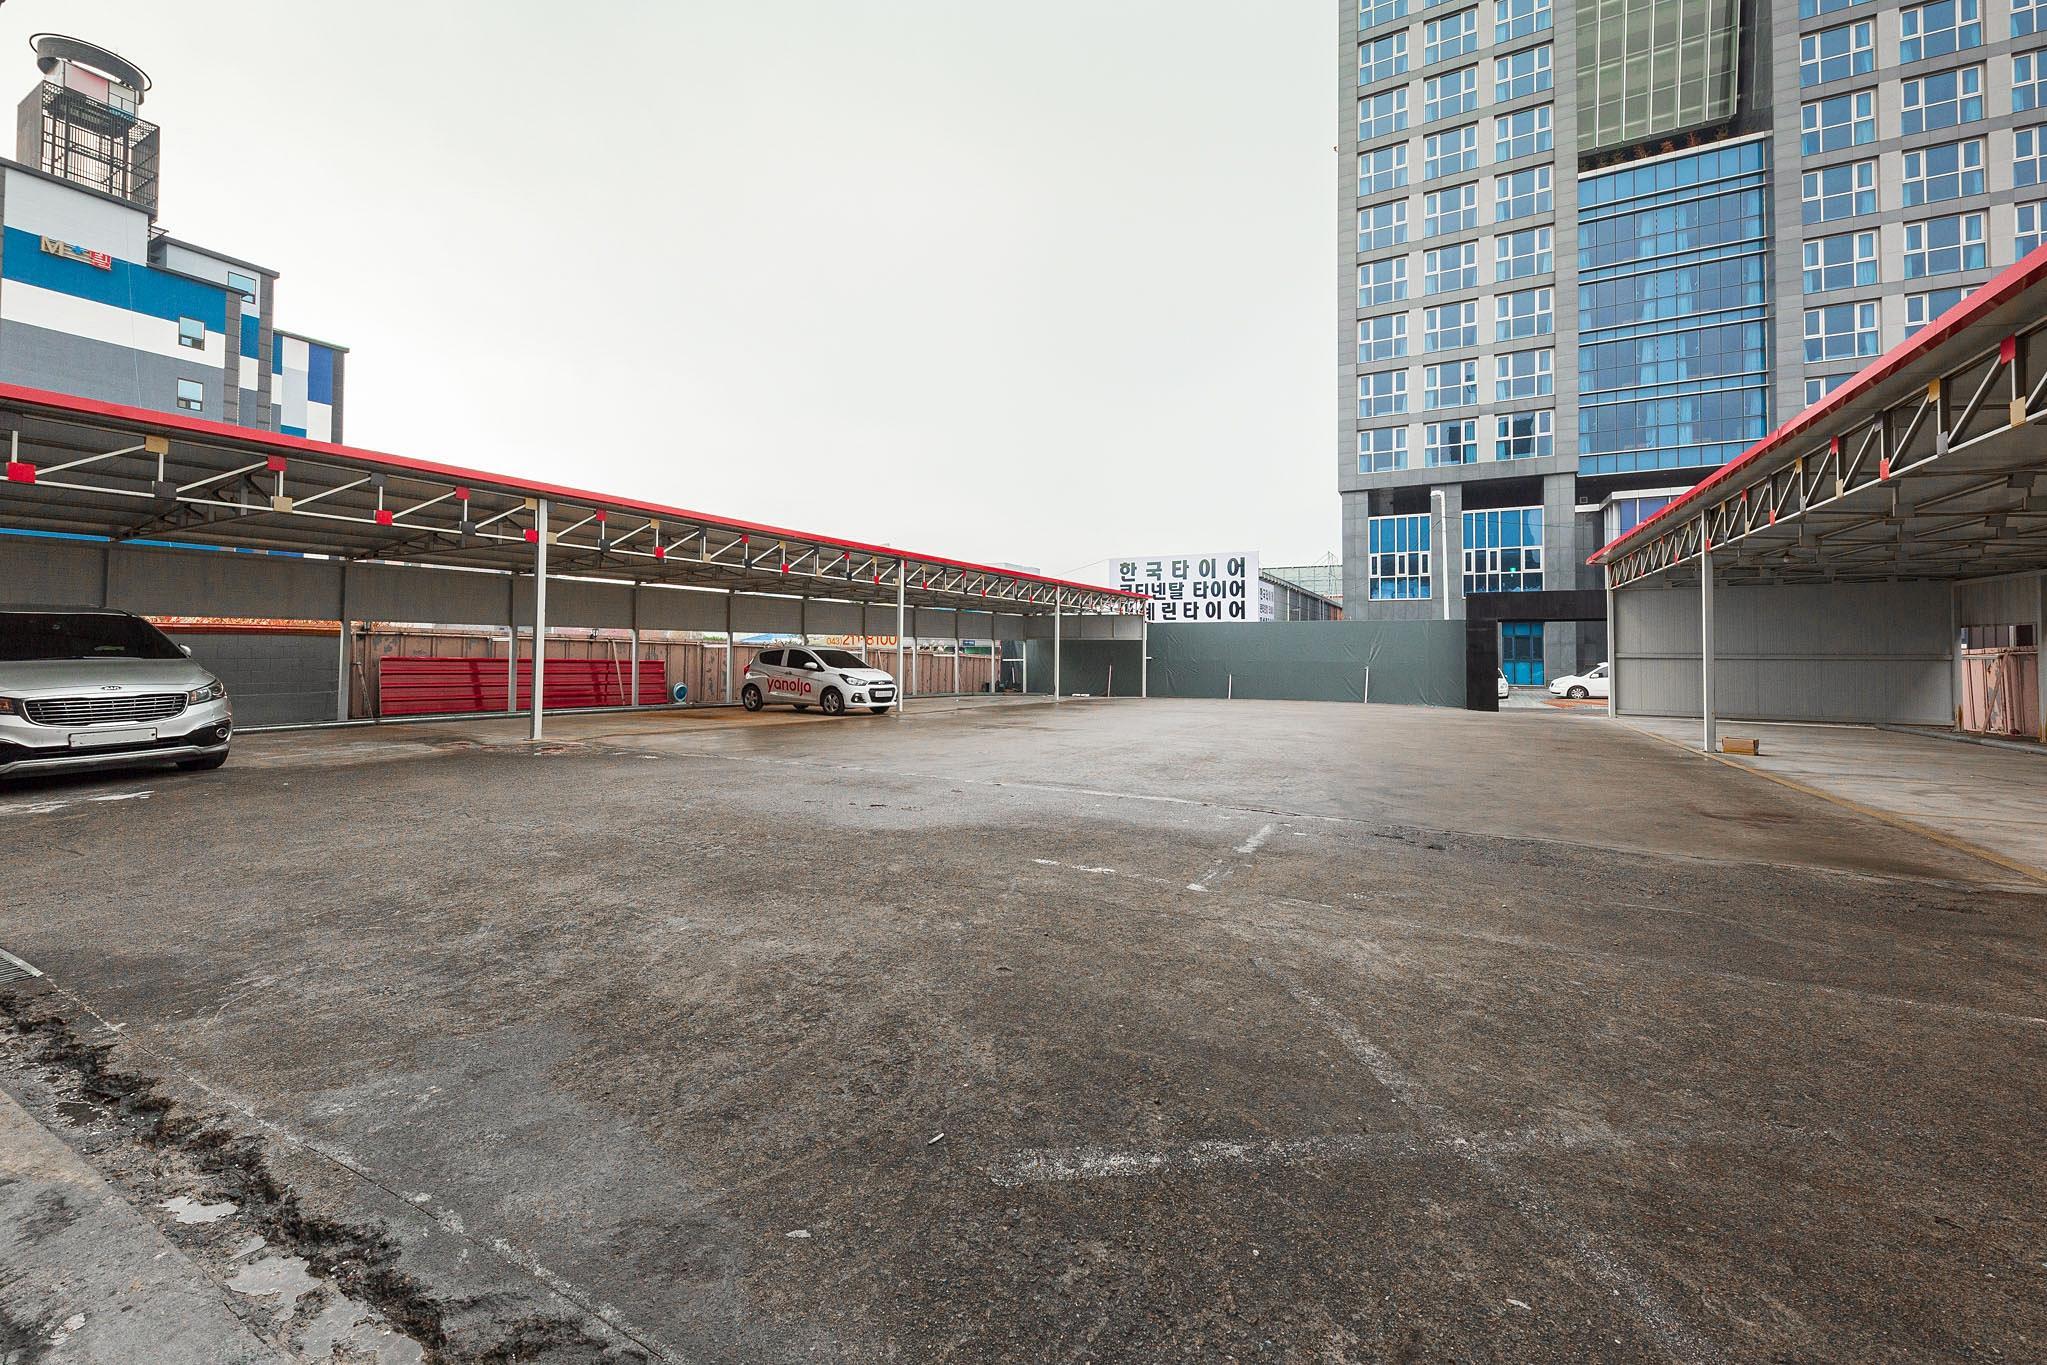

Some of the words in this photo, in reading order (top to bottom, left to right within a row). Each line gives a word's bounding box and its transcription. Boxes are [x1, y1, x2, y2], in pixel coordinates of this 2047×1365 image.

[1120, 557, 1245, 582] 한국타이어
[1193, 580, 1245, 599] 타이어
[766, 676, 811, 697] yanolja
